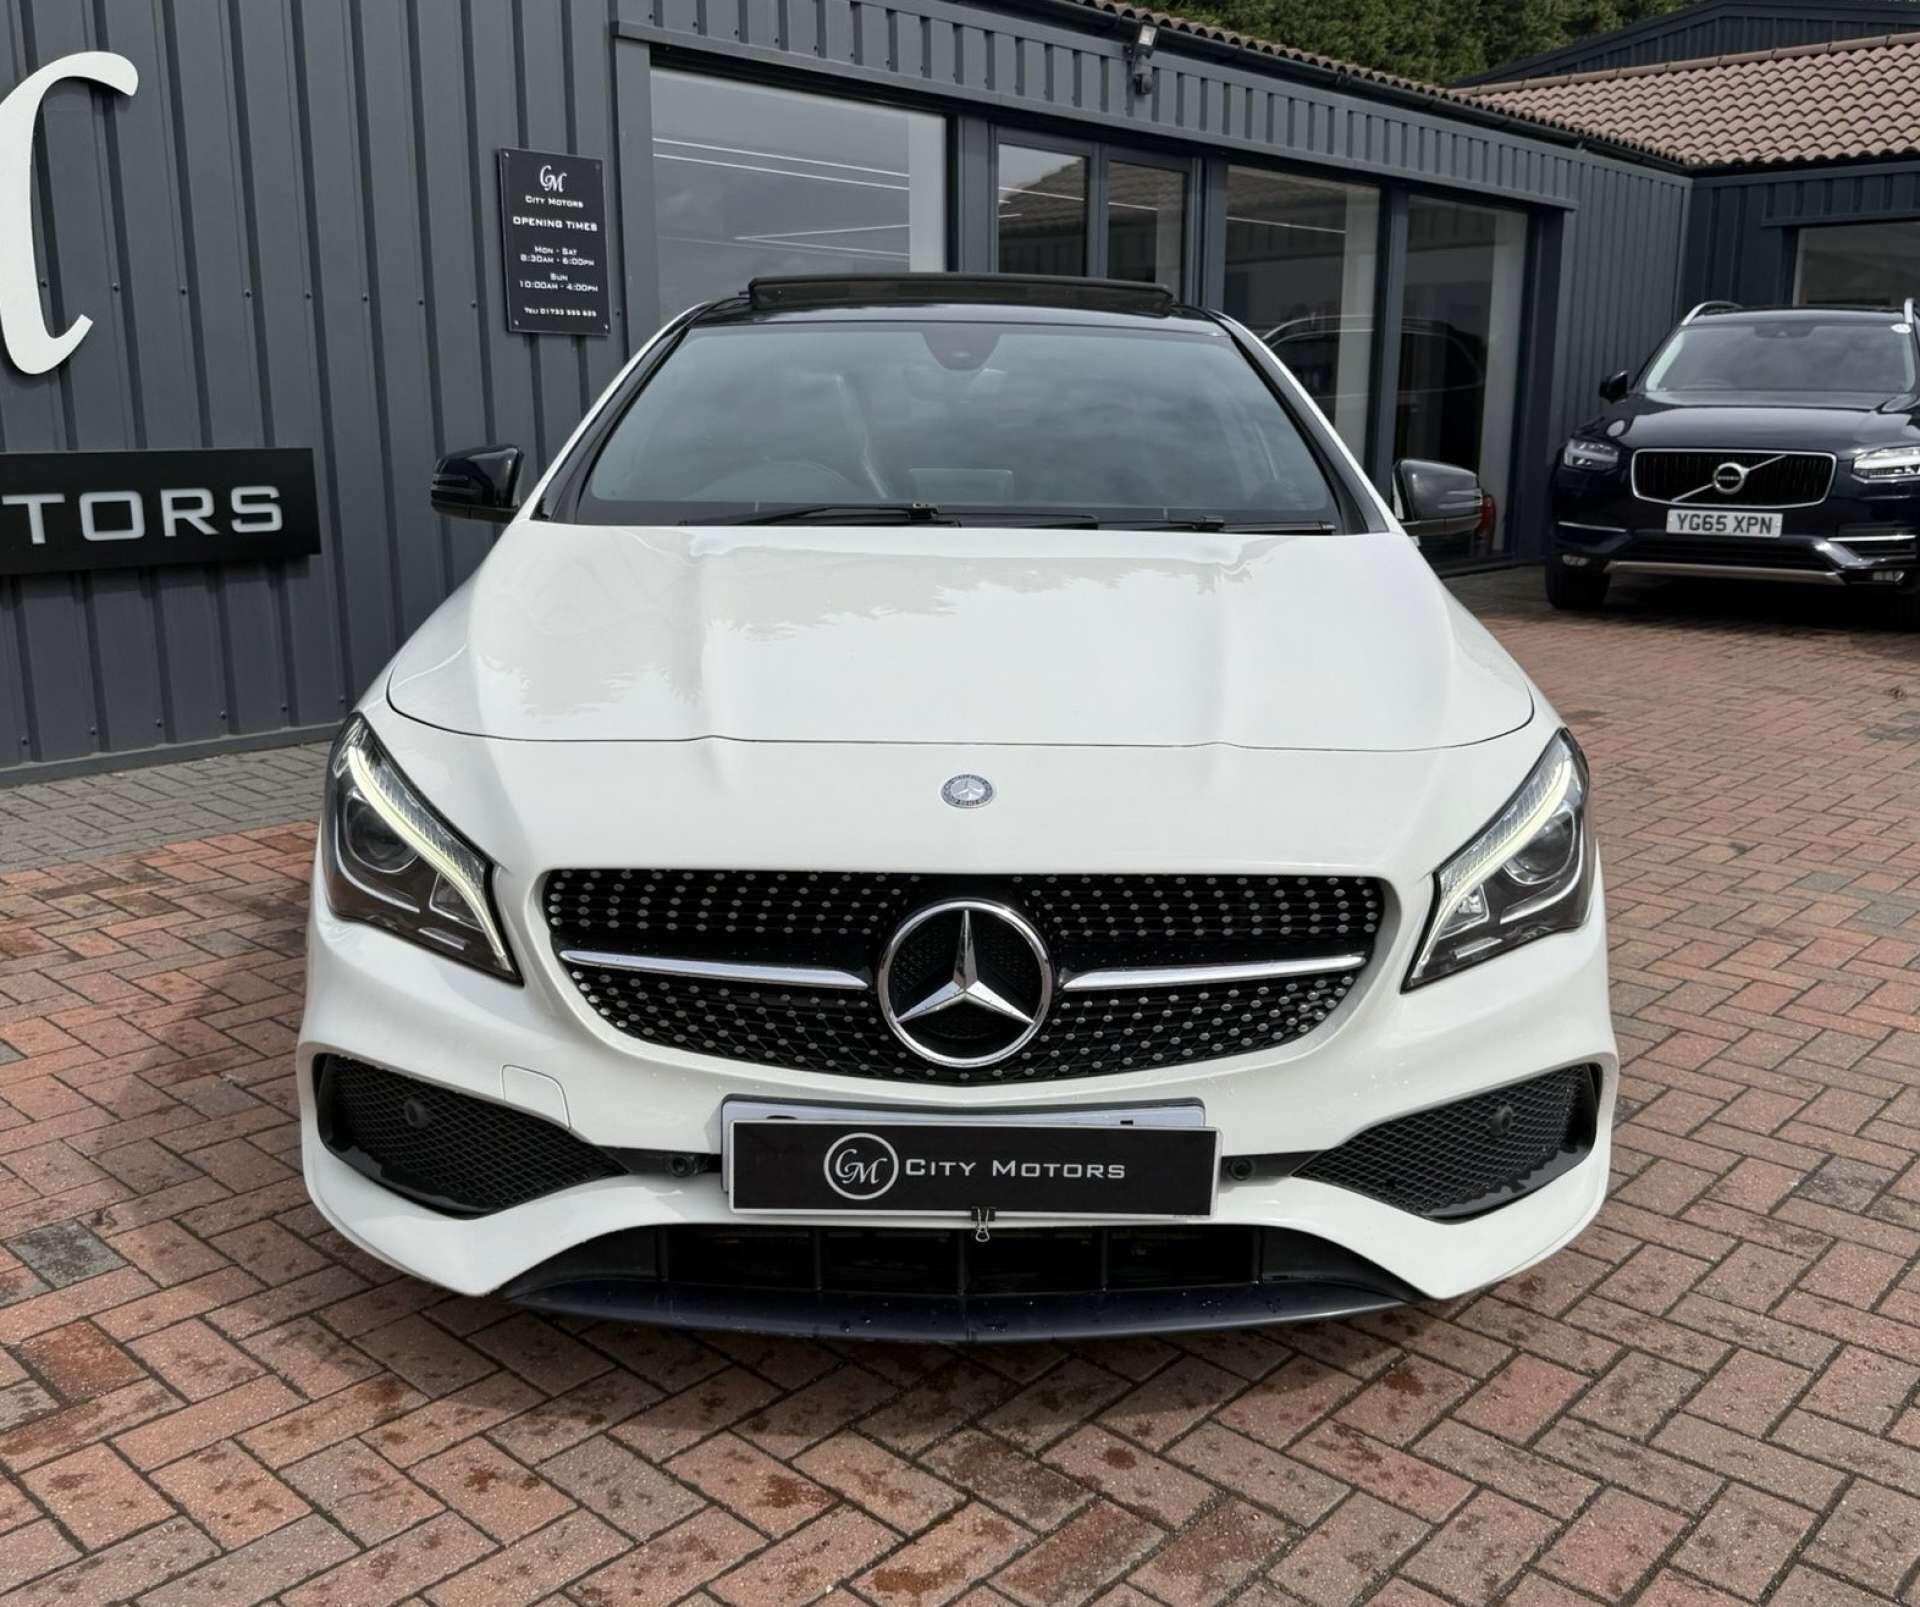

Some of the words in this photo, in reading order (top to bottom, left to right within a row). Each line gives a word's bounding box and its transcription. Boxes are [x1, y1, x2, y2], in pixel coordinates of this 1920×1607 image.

[525, 195, 546, 205] CITY
[548, 197, 584, 209] MOTORS
[512, 216, 564, 229] OPENING
[566, 220, 598, 232] TIMES
[534, 246, 554, 255] MON
[562, 248, 577, 256] SAT
[550, 272, 568, 282] SUN
[1677, 514, 1727, 532] YG65
[1732, 516, 1773, 534] XPN
[904, 1158, 977, 1178] CITY
[992, 1160, 1126, 1180] MOTORS
